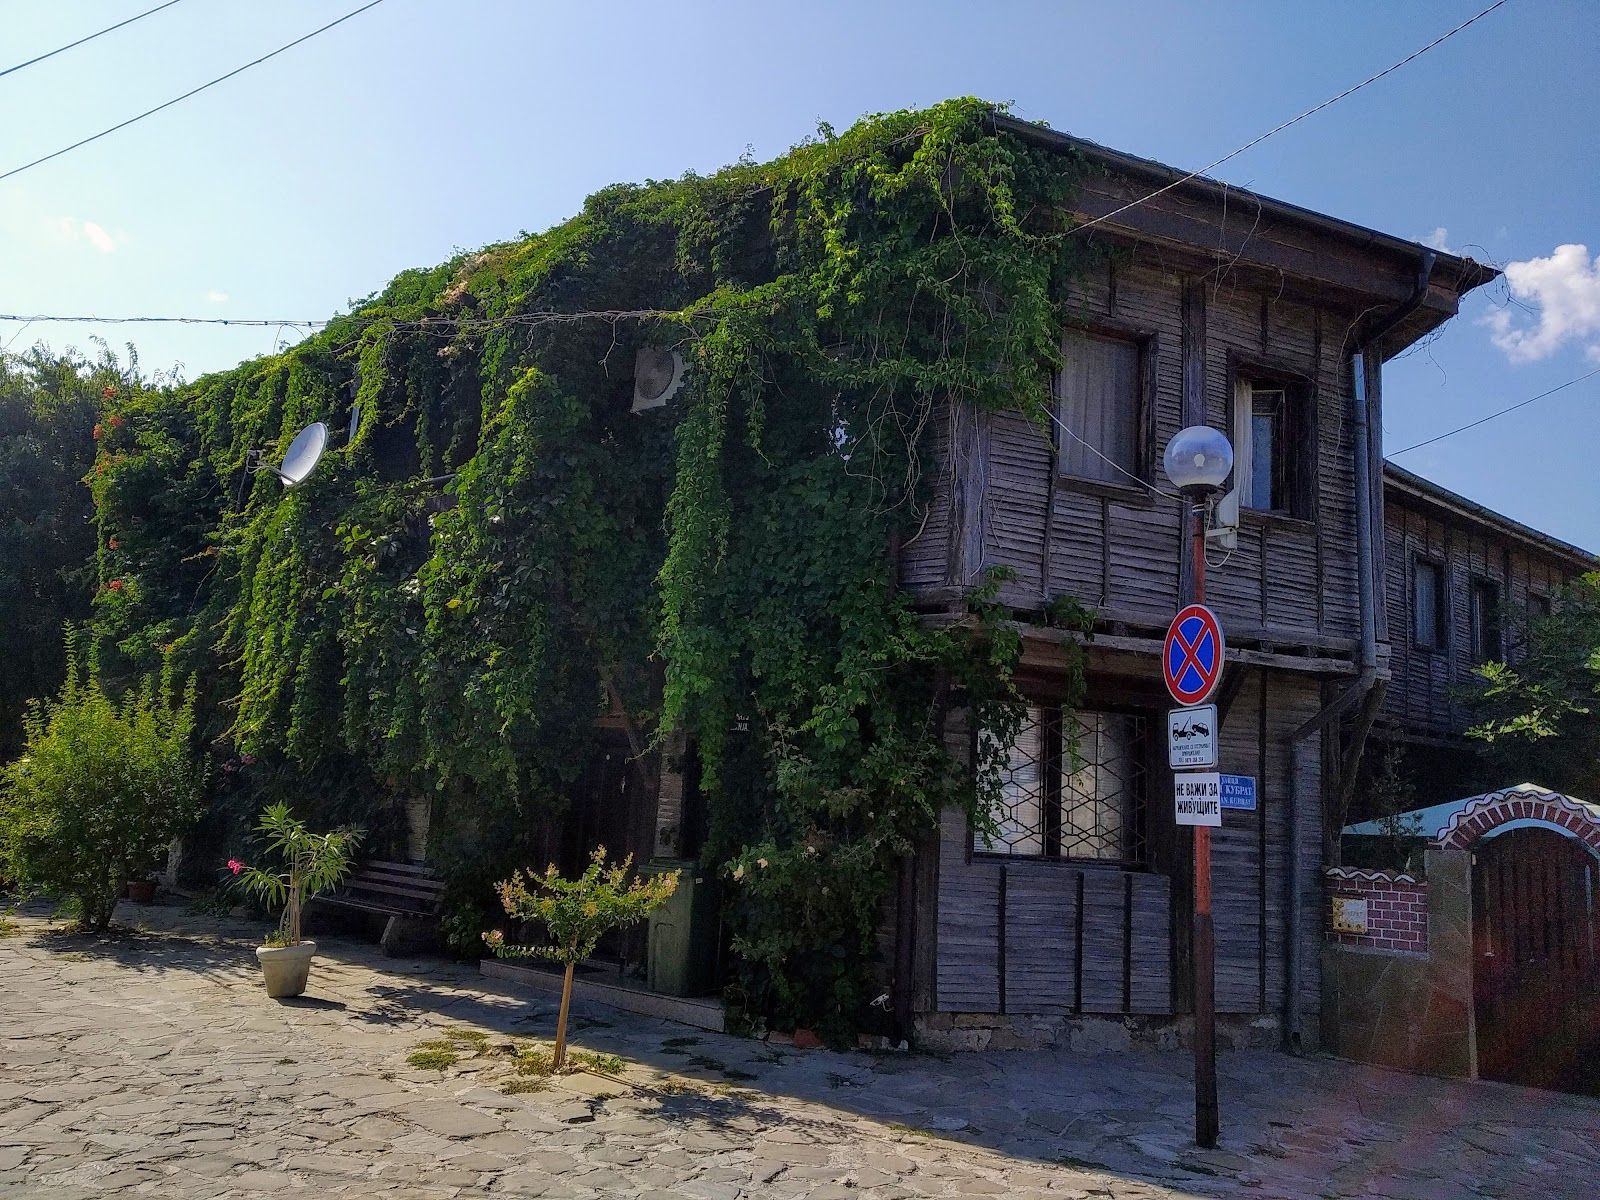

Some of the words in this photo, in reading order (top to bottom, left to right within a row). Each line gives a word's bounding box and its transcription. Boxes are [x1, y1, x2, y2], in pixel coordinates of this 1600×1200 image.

[1176, 783, 1185, 797] НЕ
[1186, 783, 1207, 797] ВАЖИ
[1209, 783, 1218, 796] ЗА
[1225, 785, 1252, 796] КУБРАТ
[1177, 801, 1218, 816] ЖИВУЩИТЕ
